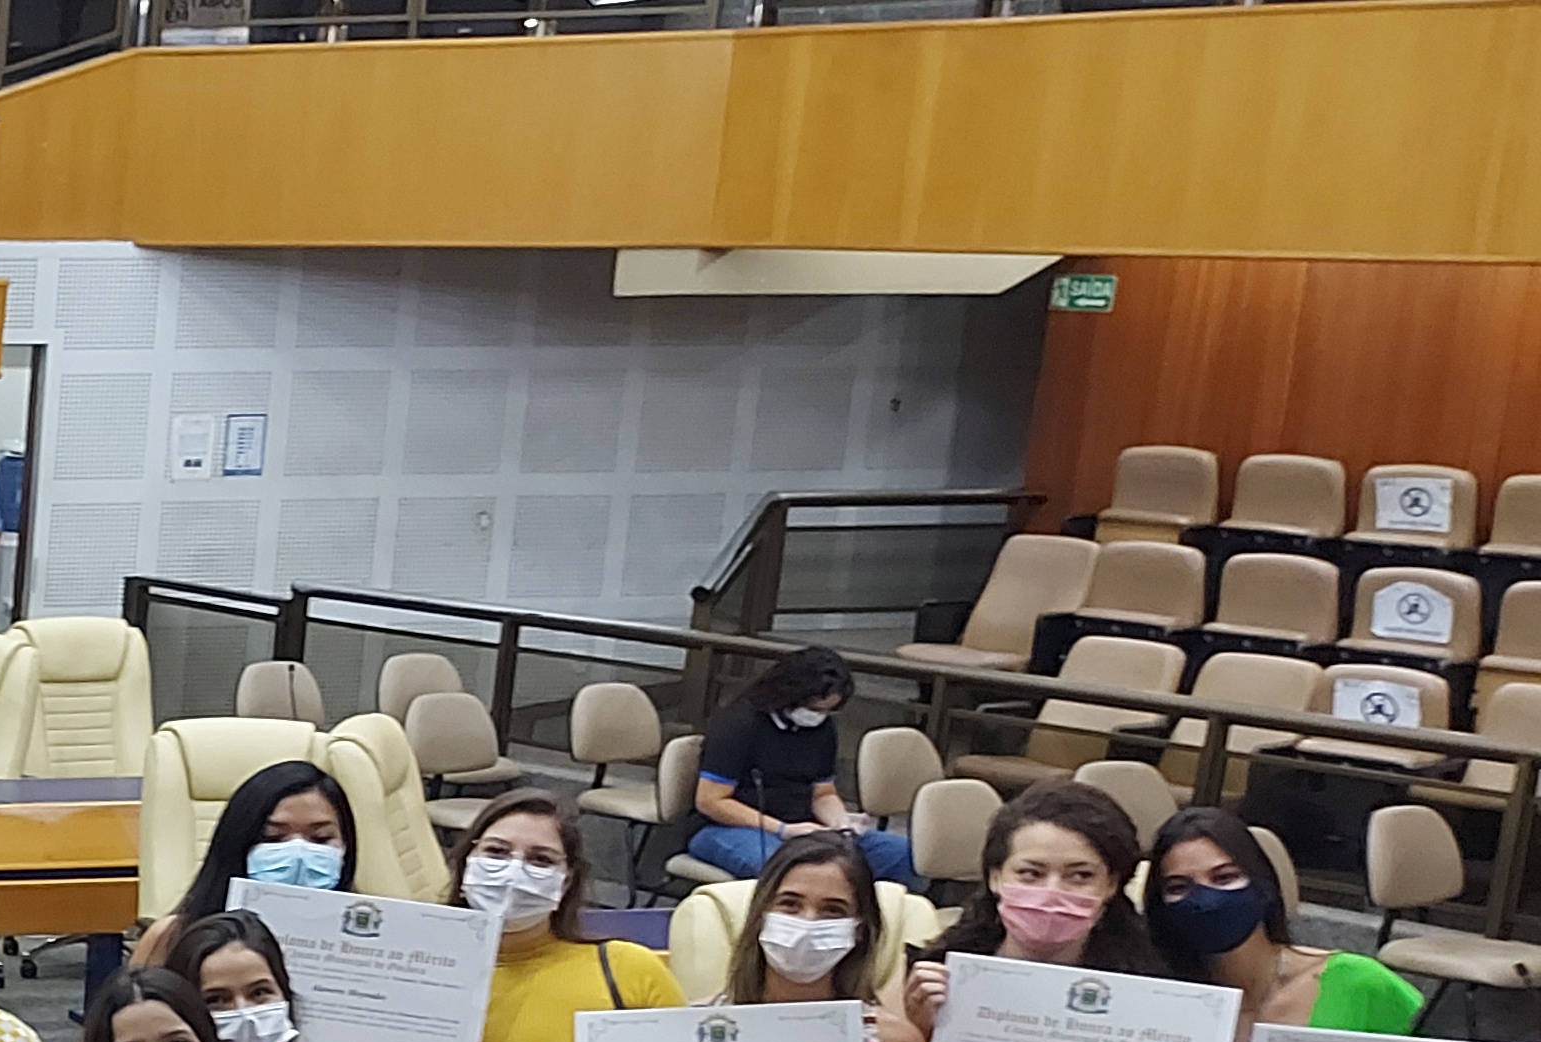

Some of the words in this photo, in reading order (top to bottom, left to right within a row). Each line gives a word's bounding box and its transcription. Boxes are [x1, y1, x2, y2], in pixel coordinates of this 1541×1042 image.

[1069, 279, 1111, 297] SAÍDA
[976, 1005, 1039, 1026] Diploma
[1042, 1014, 1059, 1028] de
[1064, 1016, 1113, 1036] Honra
[1116, 1026, 1135, 1038] ao
